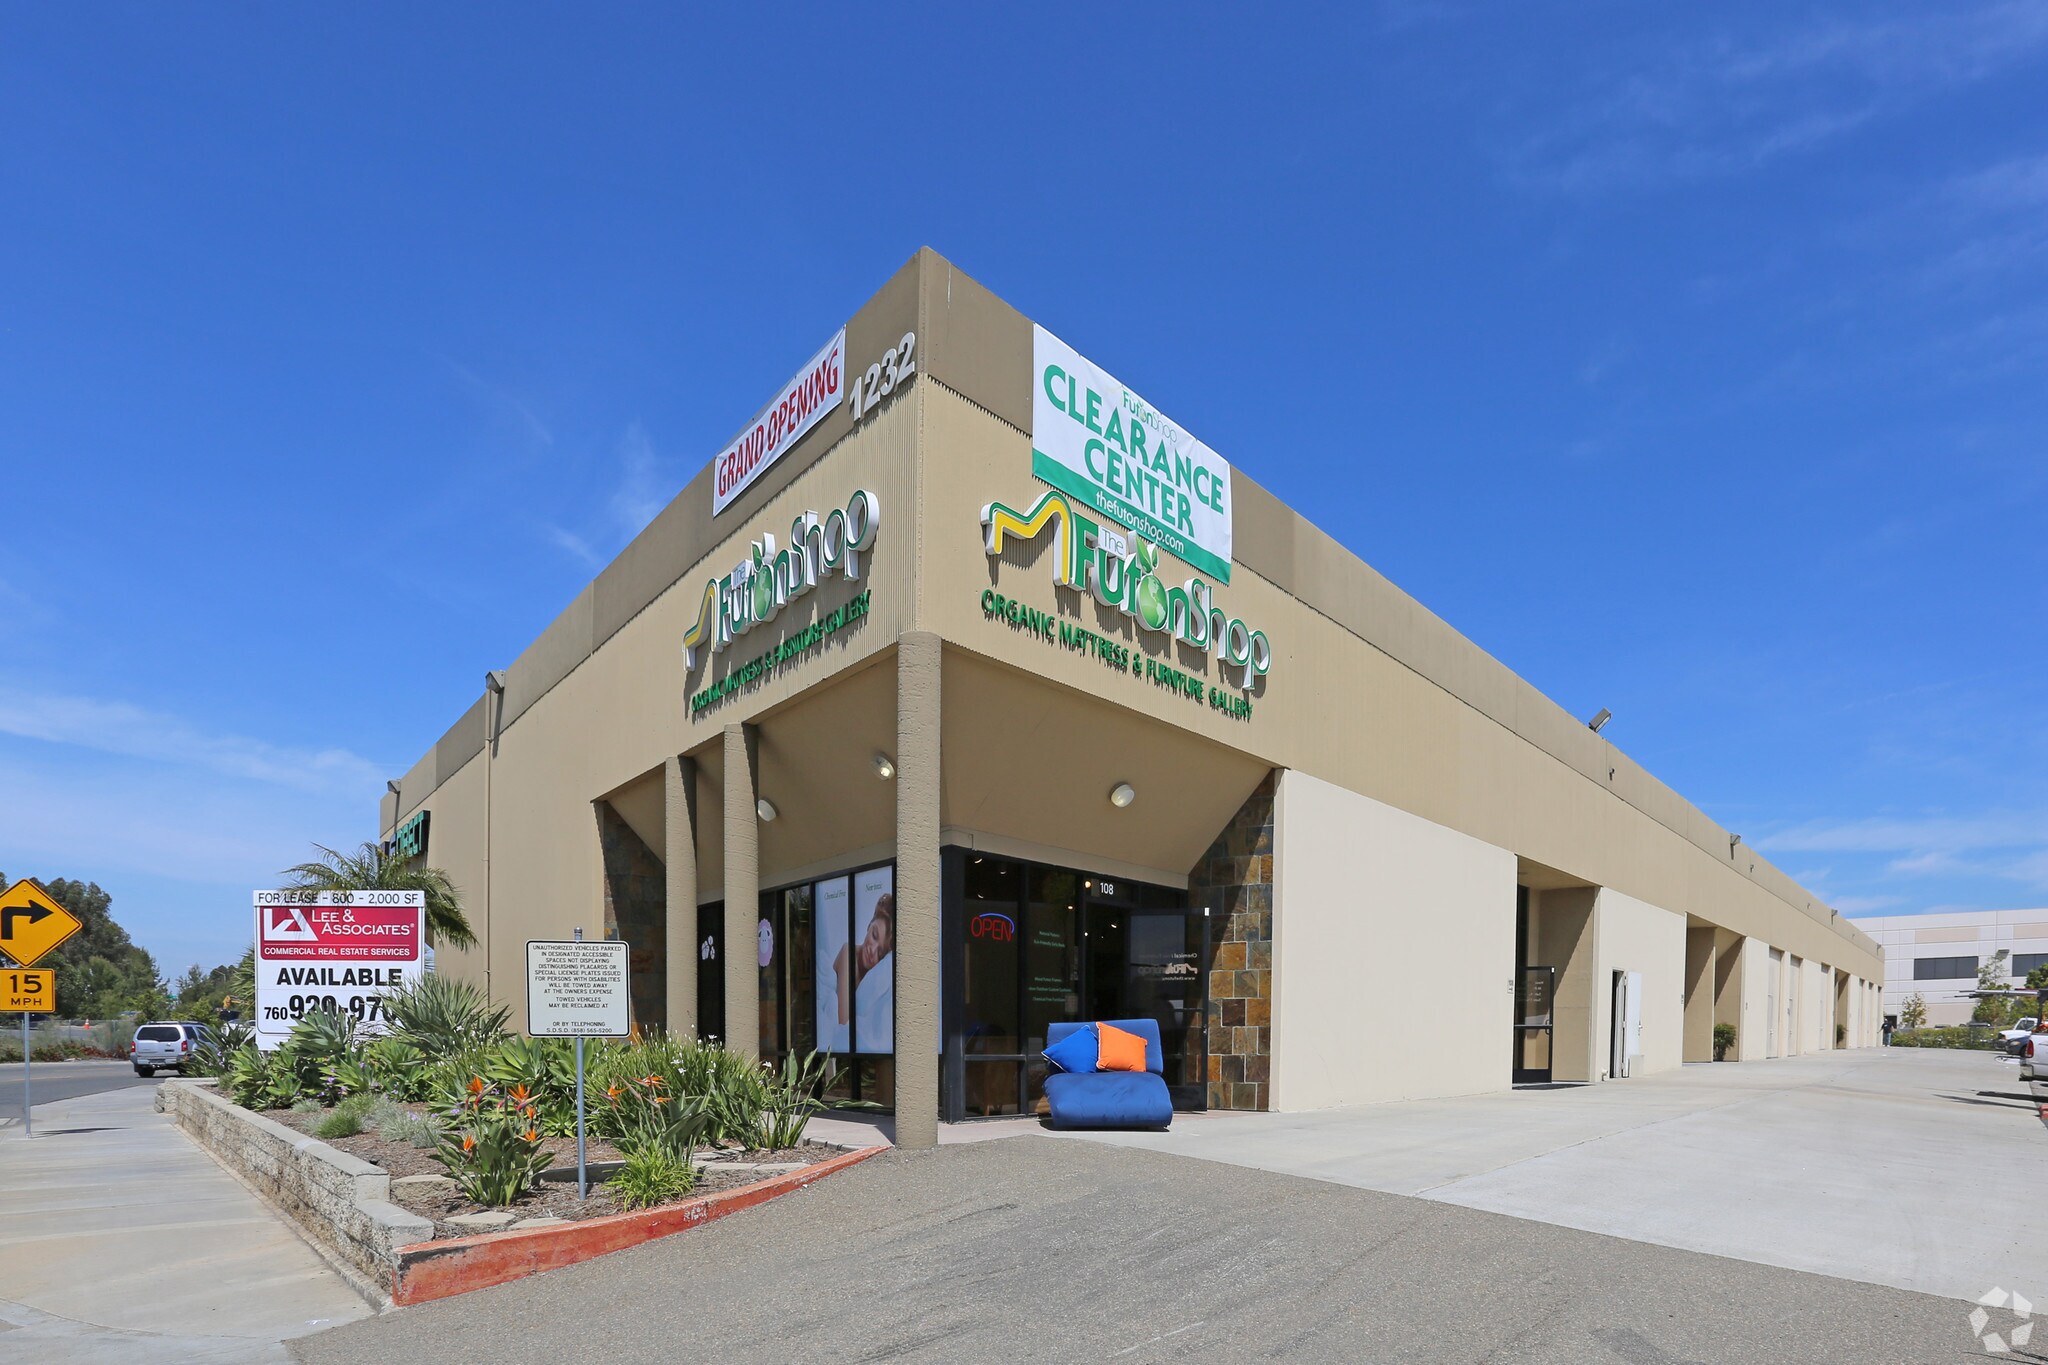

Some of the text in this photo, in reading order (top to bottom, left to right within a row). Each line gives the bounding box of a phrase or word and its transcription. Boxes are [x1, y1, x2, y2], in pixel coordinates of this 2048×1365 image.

[850, 332, 916, 421] 1232
[718, 348, 838, 497] GRAND OPENING
[1043, 364, 1224, 515] CLEARANCE
[1084, 438, 1196, 538] CENTER
[1096, 490, 1185, 554] thefutonshop.com
[1102, 527, 1124, 555] The
[765, 652, 773, 670] &
[825, 589, 872, 635] GALLERY
[981, 588, 1254, 720] ORGANIC MATTRESS & FURNITURE GALLERY
[258, 893, 281, 903] FOR
[284, 892, 318, 904] LEASE
[332, 893, 355, 904] 800
[368, 893, 400, 905] 2,000
[404, 893, 419, 904] SF
[1100, 882, 1114, 895] 108
[342, 908, 356, 923] &
[970, 916, 1013, 942] OPEN
[264, 947, 410, 956] COMMERCIAL REAL ESTATE SERVICES
[9, 974, 43, 993] 15
[276, 967, 403, 987] AVAILABLE
[11, 998, 42, 1006] MPH
[264, 1006, 288, 1020] 760
